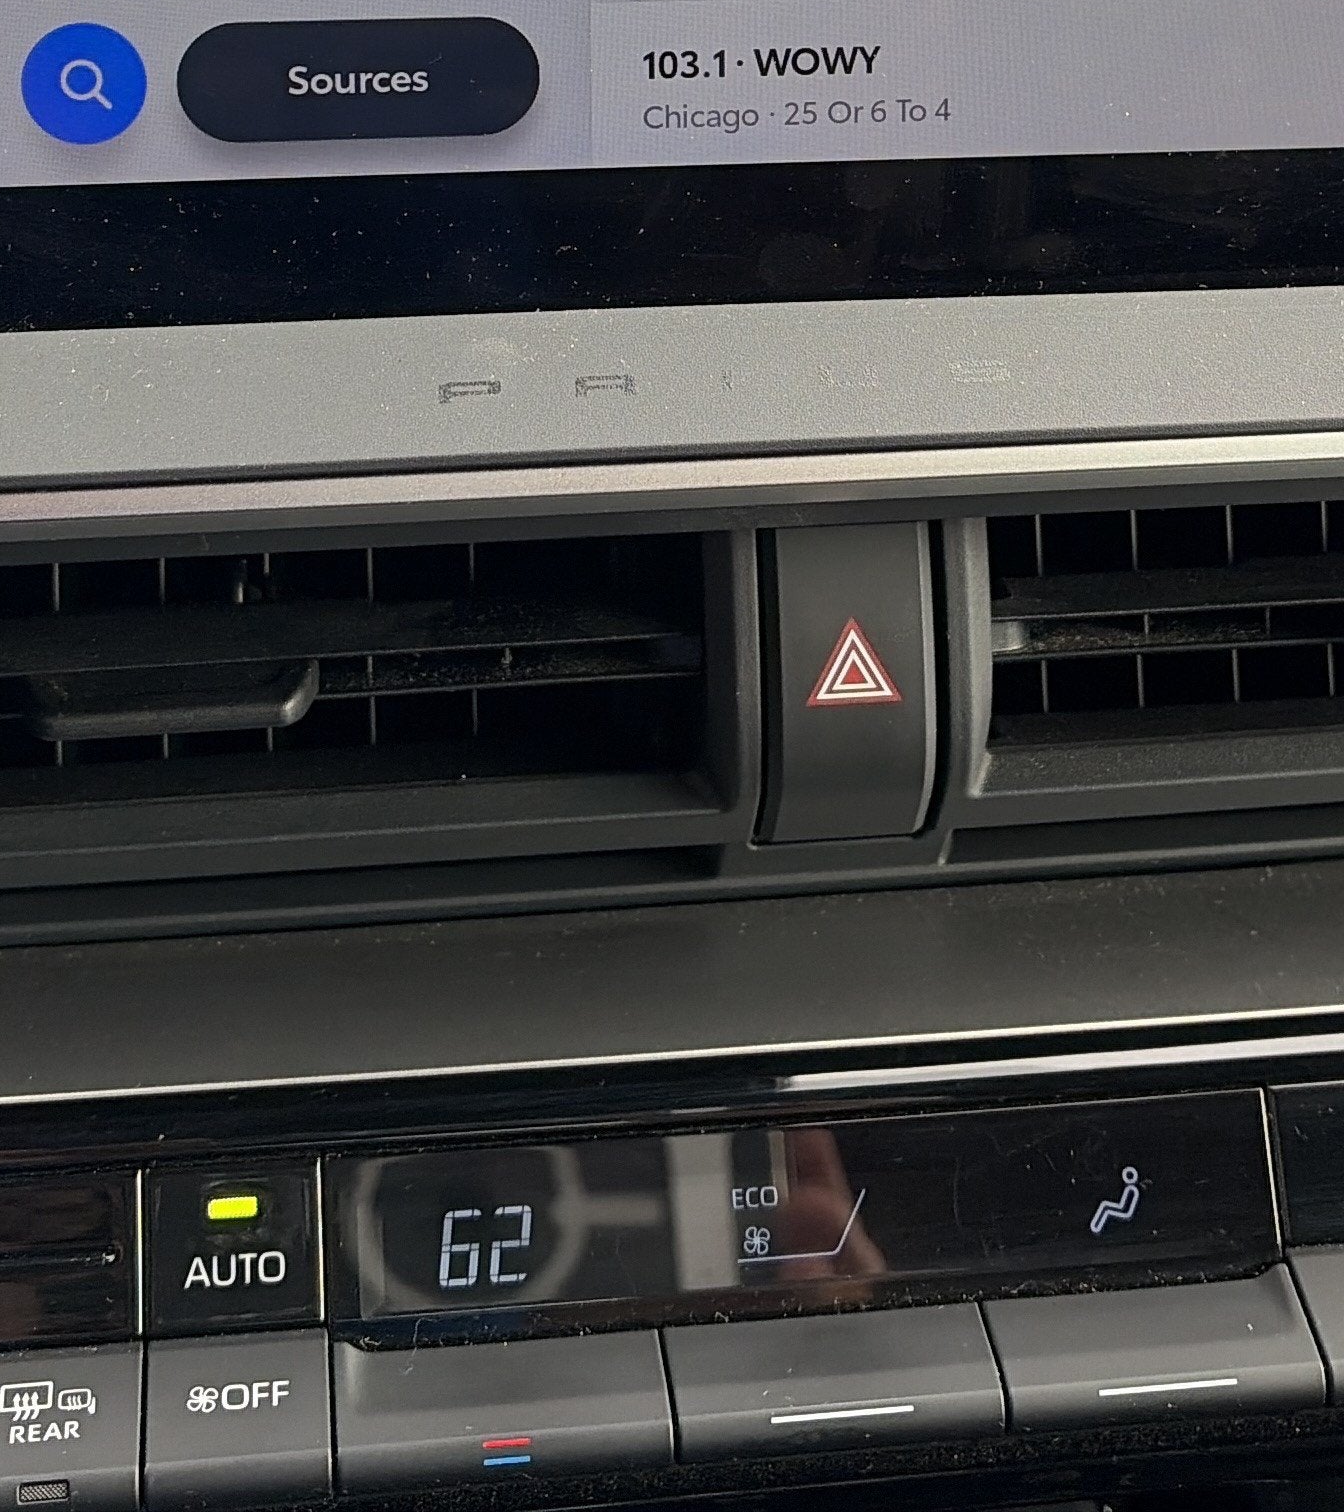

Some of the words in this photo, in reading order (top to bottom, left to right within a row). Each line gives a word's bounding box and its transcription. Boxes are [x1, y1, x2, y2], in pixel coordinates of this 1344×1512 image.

[643, 49, 726, 80] 103.1
[753, 45, 881, 77] WOWY
[288, 65, 429, 95] Sources
[643, 103, 760, 135] Chicago
[784, 101, 818, 126] 25
[827, 100, 864, 125] Or
[870, 99, 887, 123] 6
[895, 98, 927, 123] To
[934, 97, 952, 122] 4
[730, 1184, 780, 1210] ECO
[438, 1204, 532, 1288] 62
[184, 1250, 286, 1289] AUTO
[221, 1380, 290, 1411] OFF
[9, 1419, 80, 1445] REAR
